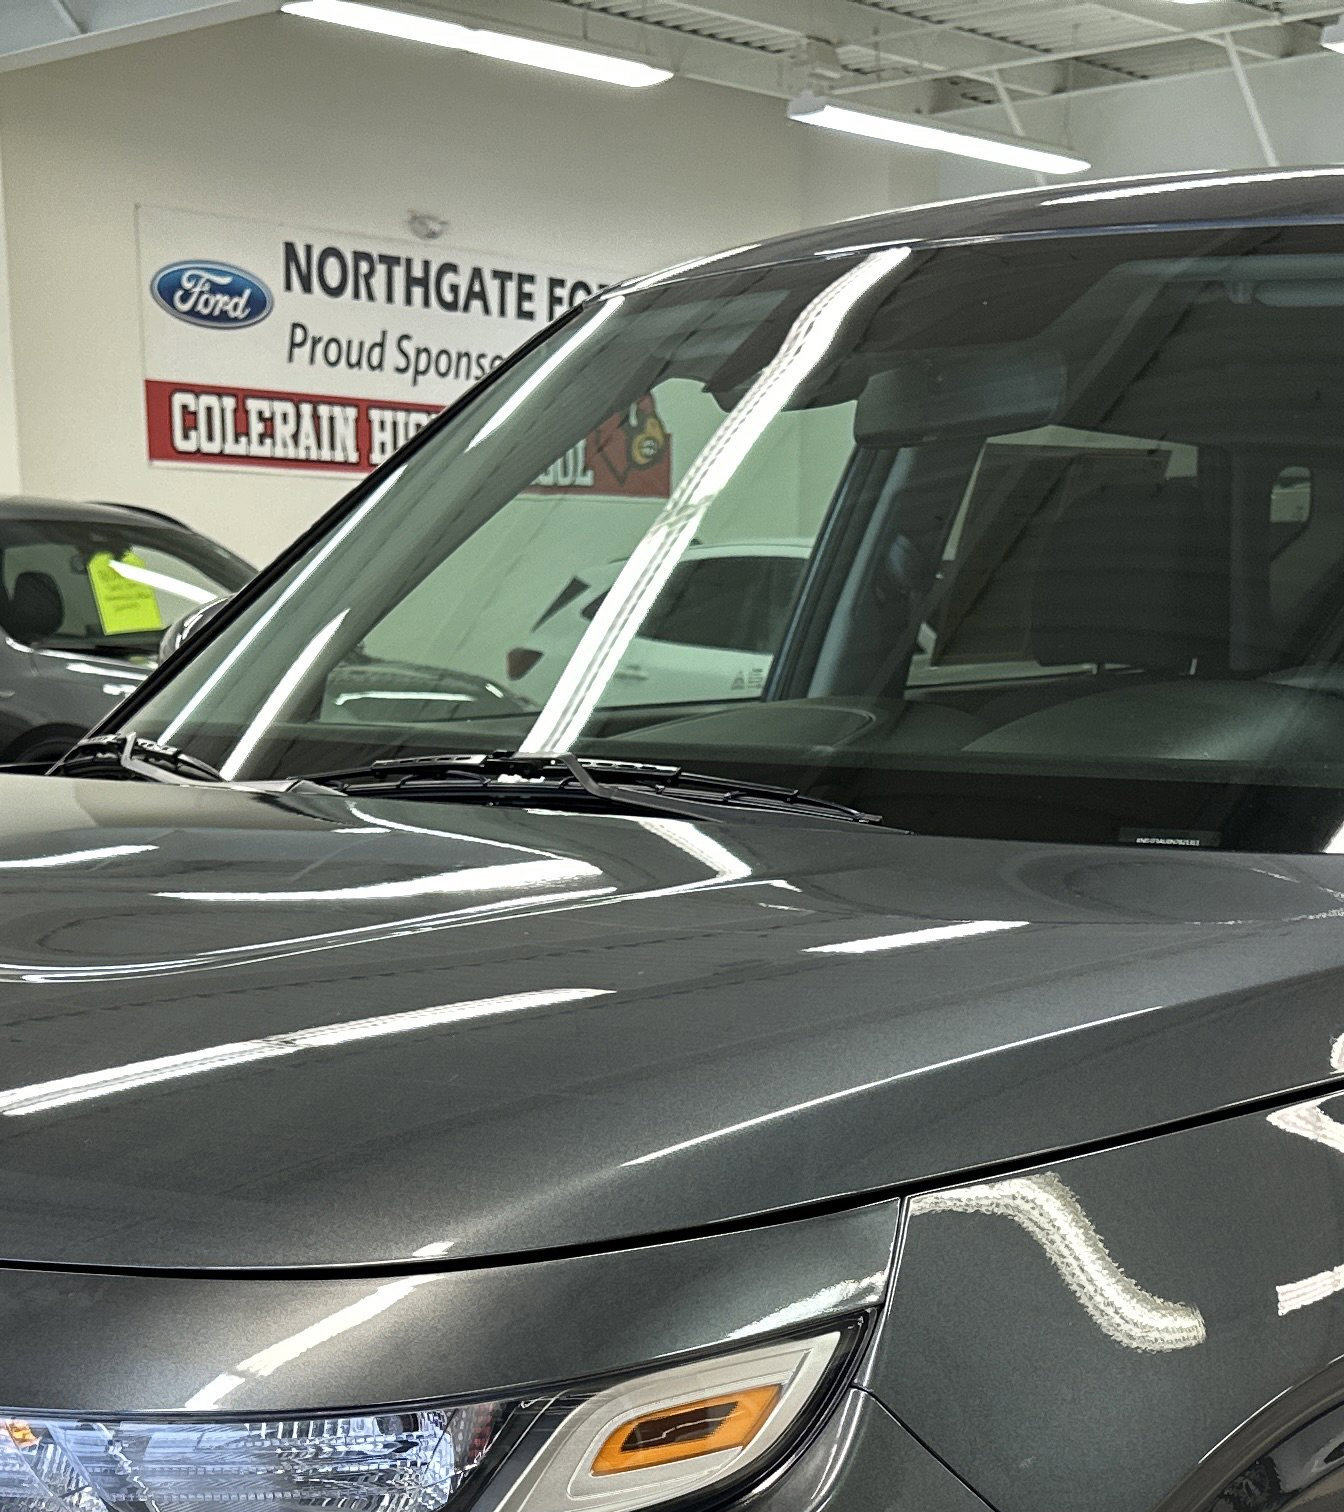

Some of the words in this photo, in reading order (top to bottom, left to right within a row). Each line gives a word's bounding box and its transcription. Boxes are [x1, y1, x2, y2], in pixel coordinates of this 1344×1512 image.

[173, 271, 252, 320] Ford
[282, 241, 536, 322] NORTHGATE
[548, 277, 609, 323] FO
[286, 322, 388, 373] Proud
[170, 389, 360, 465] COLERAIN
